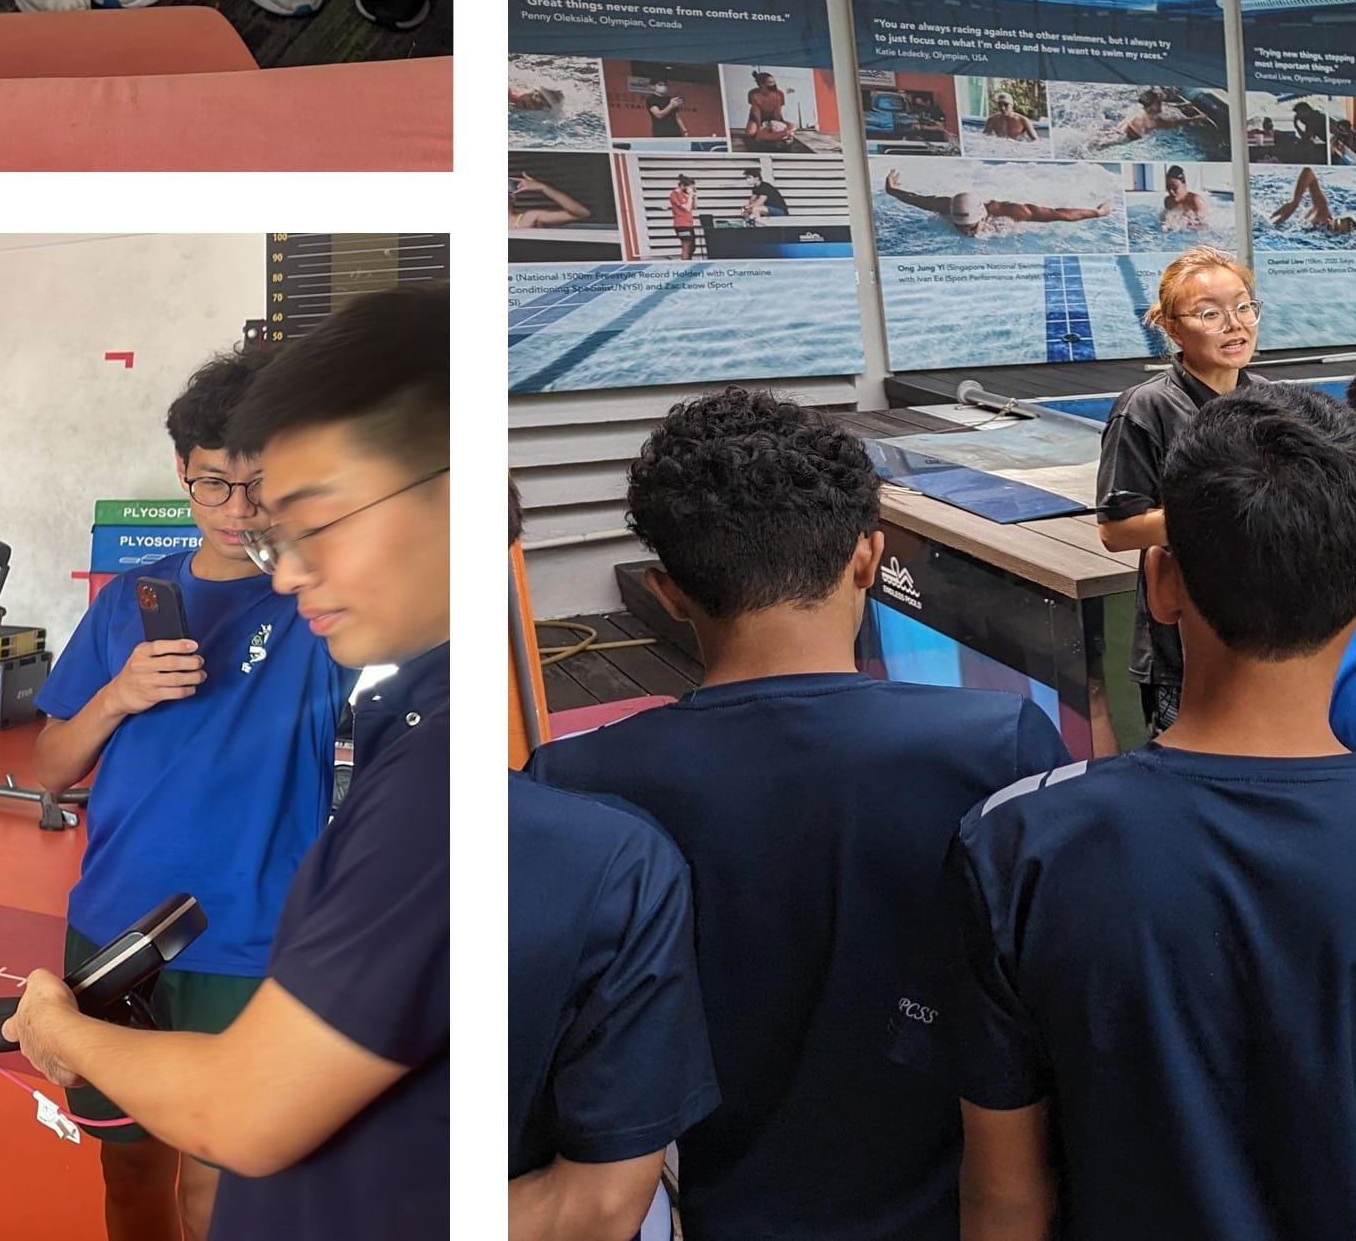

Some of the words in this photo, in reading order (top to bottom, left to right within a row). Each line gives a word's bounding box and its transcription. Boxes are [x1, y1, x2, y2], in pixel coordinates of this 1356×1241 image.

[565, 0, 604, 13] things
[606, 3, 640, 13] never
[643, 5, 673, 16] come
[676, 5, 704, 17] from
[705, 9, 750, 20] comfort
[521, 10, 551, 23] Penny
[553, 12, 597, 25] Oleksiak,
[599, 15, 647, 28] Olympian,
[648, 18, 683, 29] Canada
[900, 22, 916, 30] are
[918, 22, 951, 35] always
[953, 25, 982, 37] racing
[983, 28, 1017, 38] against
[1019, 29, 1034, 39] the
[1036, 30, 1060, 40] other
[1108, 36, 1124, 46] but
[1130, 37, 1158, 49] always
[1159, 40, 1172, 50] try
[875, 33, 886, 42] to
[888, 33, 907, 45] just
[909, 35, 936, 46] focus
[937, 38, 950, 46] on
[951, 38, 976, 48] what
[994, 41, 1021, 53] doing
[1022, 43, 1040, 53] and
[1041, 44, 1060, 54] how
[1067, 46, 1089, 56] want
[1091, 47, 1101, 57] to
[1102, 48, 1124, 58] swim
[1125, 51, 1138, 60] my
[875, 47, 897, 57] Katie
[971, 53, 989, 62] USA
[272, 253, 283, 263] 90
[516, 271, 559, 282] (National
[562, 270, 591, 280] 1500m
[638, 269, 670, 279] Record
[707, 268, 725, 277] with
[726, 268, 772, 277] Charmaine
[897, 264, 915, 273] Ong
[916, 264, 935, 273] Jung
[272, 273, 283, 283] 80
[508, 284, 570, 295] Conditioning
[645, 282, 662, 291] and
[707, 280, 734, 291] (Sport
[272, 293, 283, 303] 70
[272, 312, 283, 322] 60
[272, 331, 283, 341] 50
